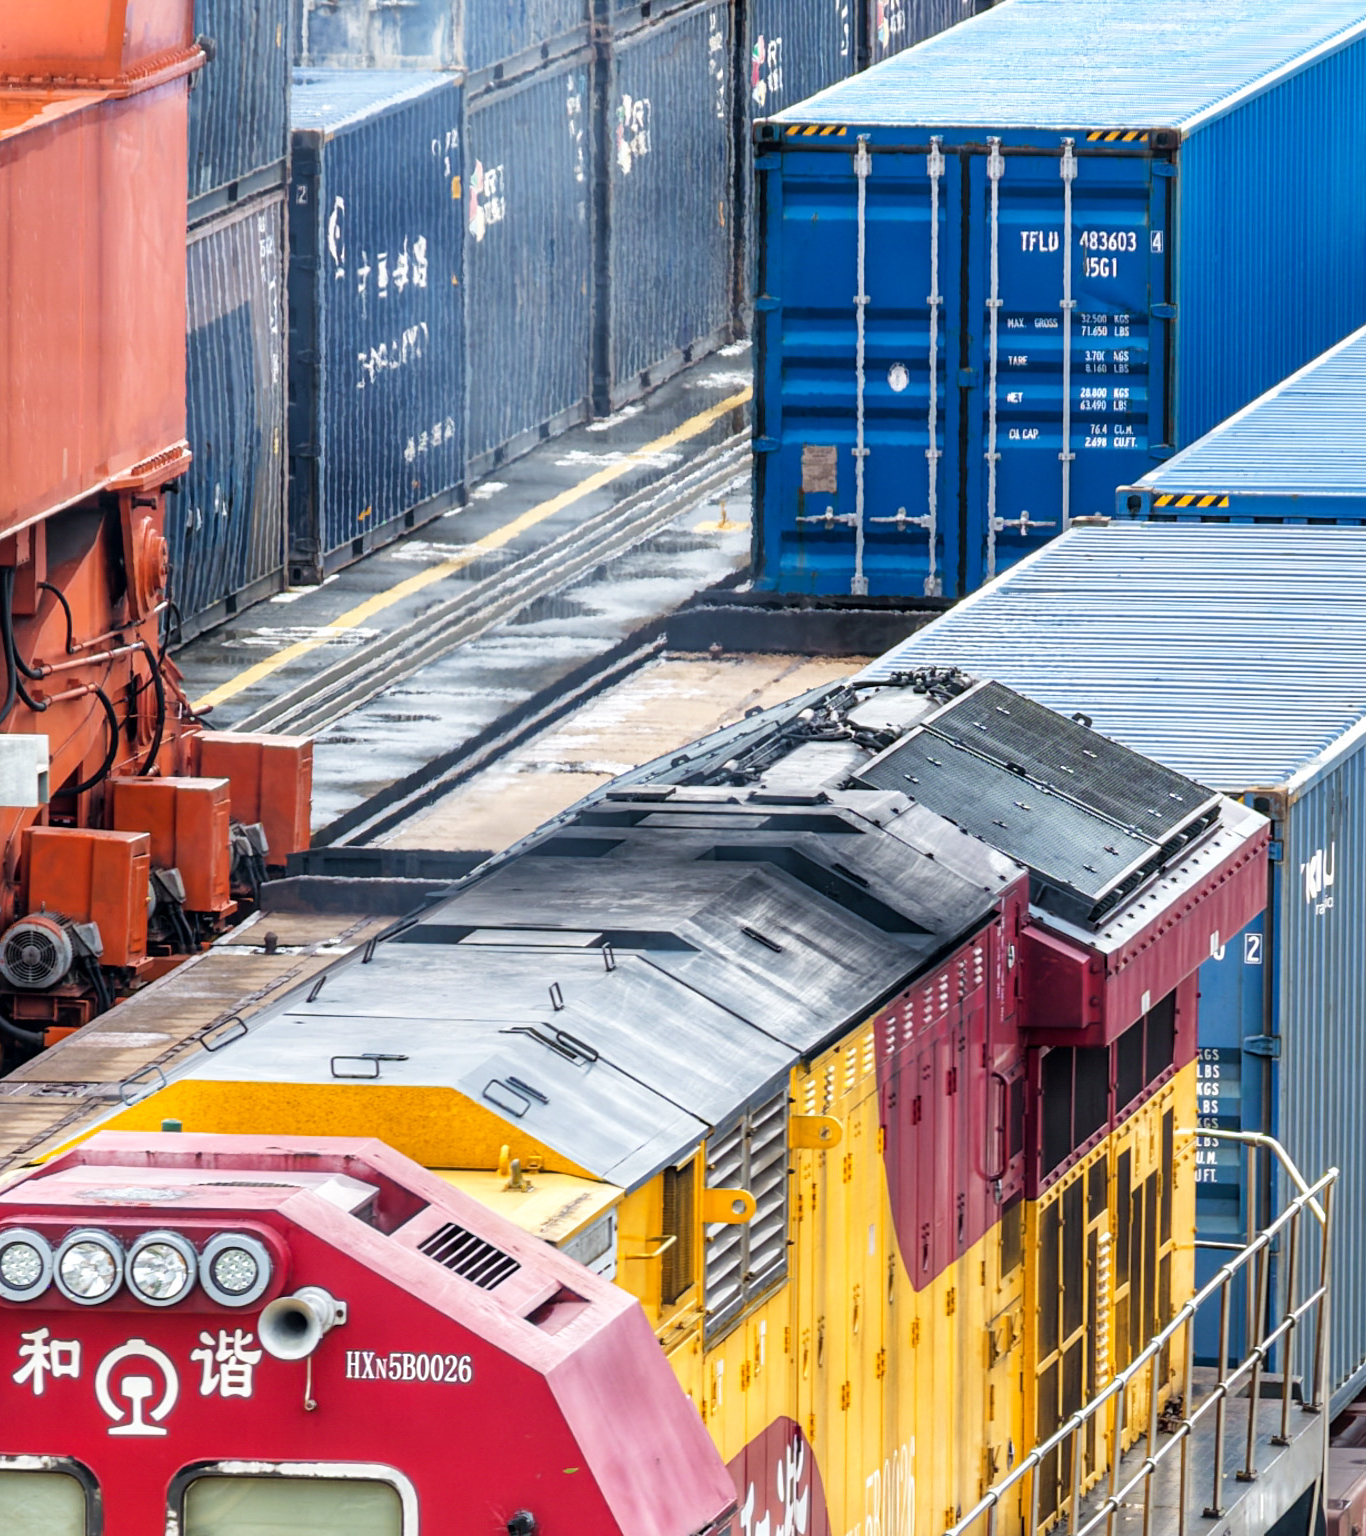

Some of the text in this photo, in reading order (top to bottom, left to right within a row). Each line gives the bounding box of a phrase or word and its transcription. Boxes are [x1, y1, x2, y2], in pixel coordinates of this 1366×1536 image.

[1020, 230, 1163, 252] TFLU 483603 4
[1113, 314, 1130, 324] KGS
[1034, 317, 1058, 328] GROSS
[1113, 326, 1130, 337] LBS
[1008, 355, 1029, 366] TARE
[1113, 364, 1130, 373] LBS
[1113, 387, 1130, 398] KGS
[1246, 935, 1261, 963] 2
[1196, 1064, 1220, 1079] LBS
[12, 1327, 263, 1398] 和 谐
